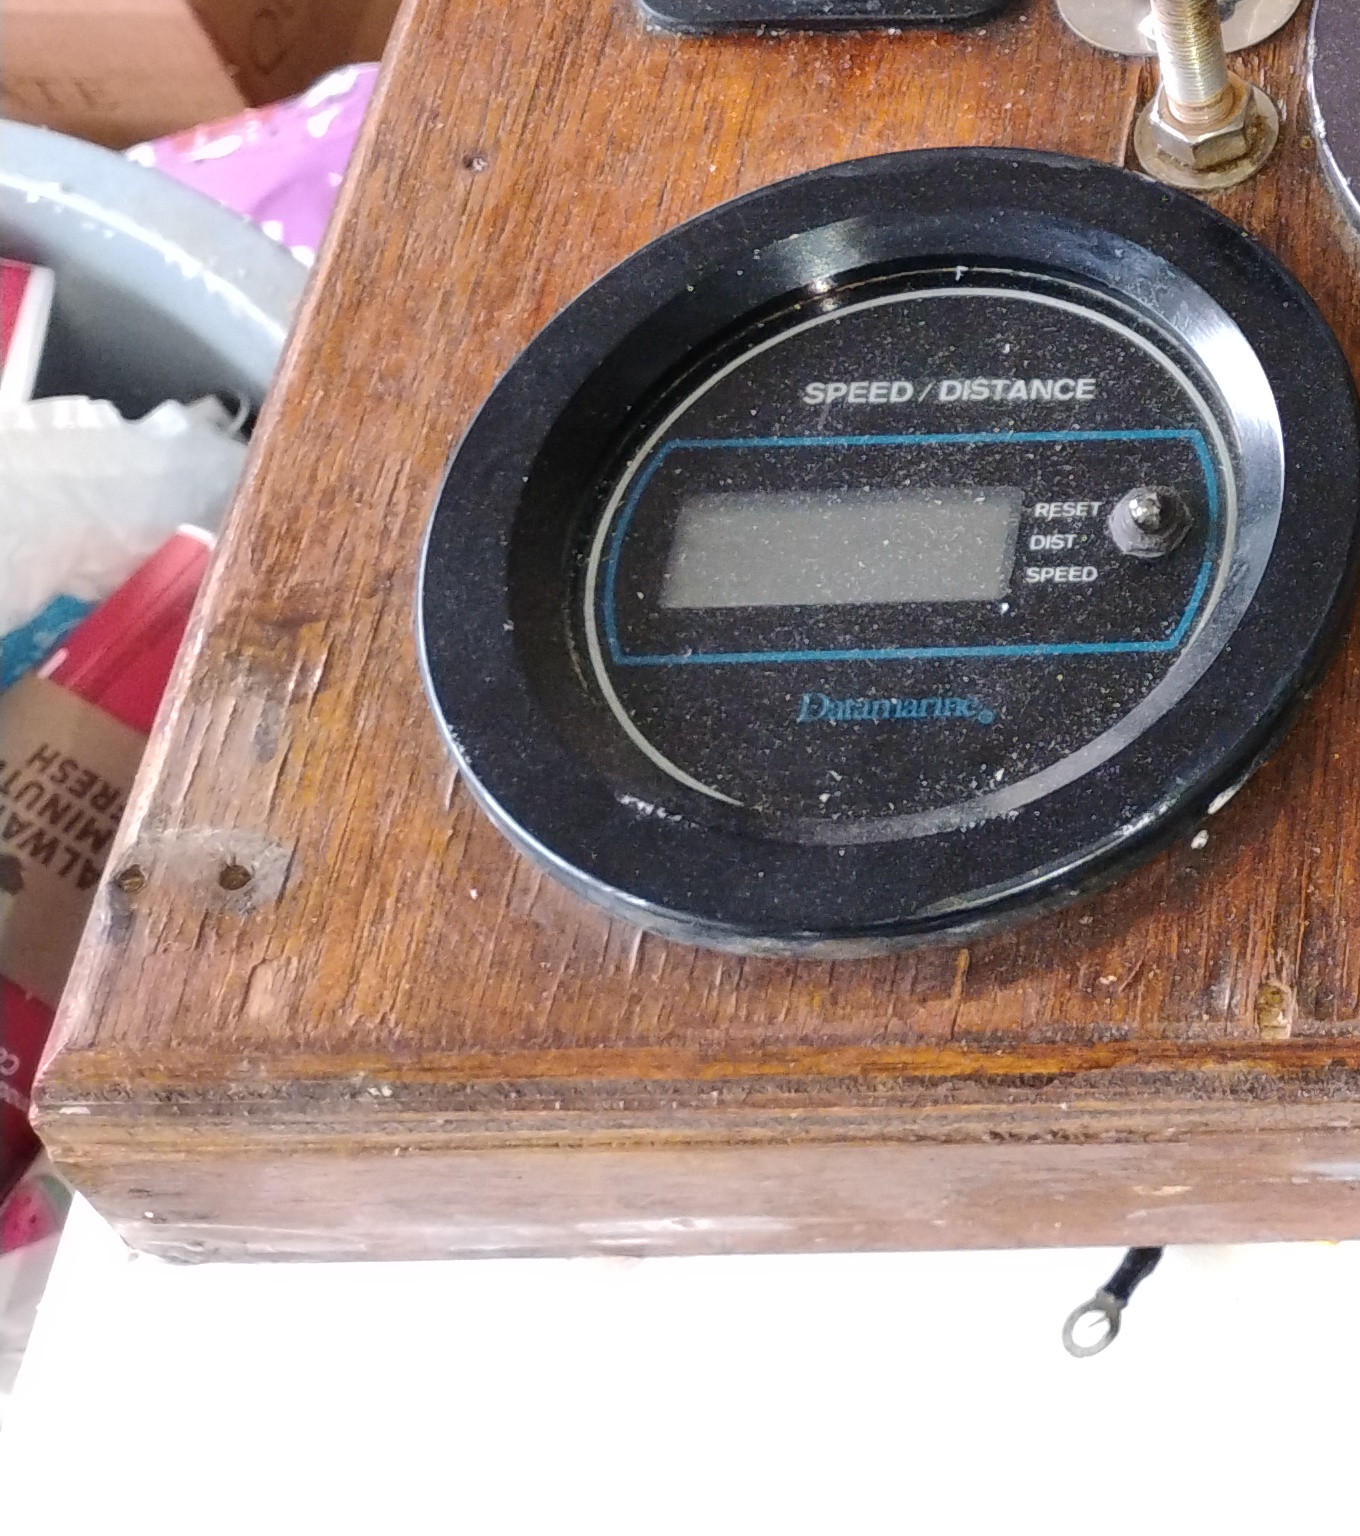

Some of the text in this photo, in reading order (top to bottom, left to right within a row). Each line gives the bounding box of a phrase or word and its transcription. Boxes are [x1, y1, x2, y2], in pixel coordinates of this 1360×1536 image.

[803, 380, 914, 405] SPEED
[937, 377, 1097, 402] DISTANCE
[1034, 501, 1103, 518] RESET
[1025, 566, 1099, 583] SPEED
